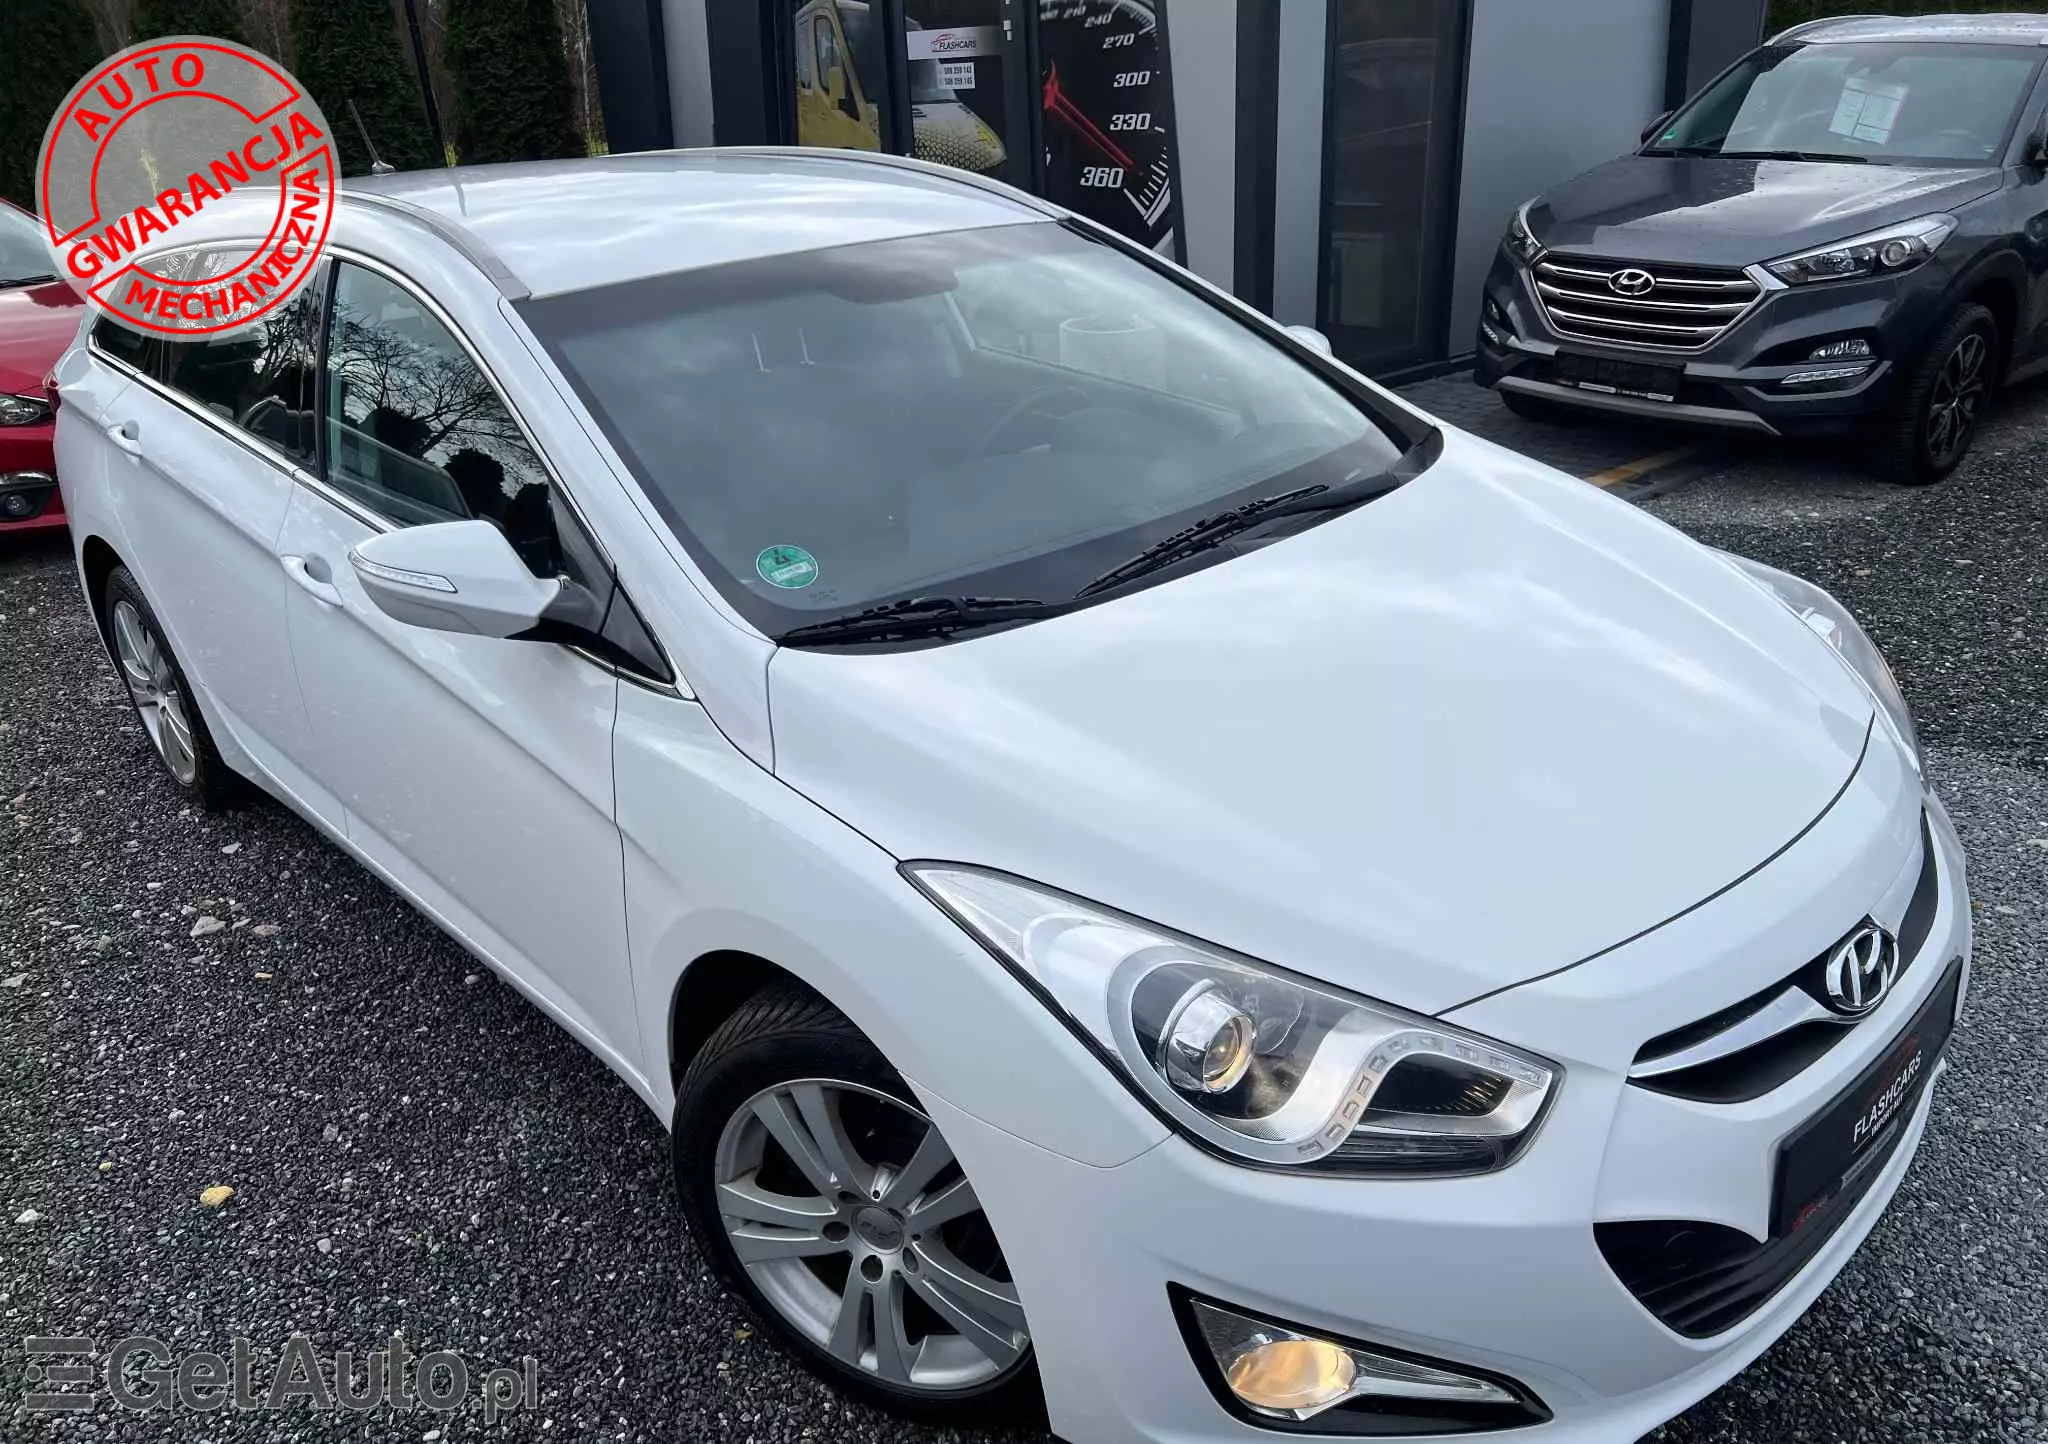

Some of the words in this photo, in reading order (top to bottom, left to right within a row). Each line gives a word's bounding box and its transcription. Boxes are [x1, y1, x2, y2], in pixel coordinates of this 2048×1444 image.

[939, 40, 977, 50] FLASHCARS
[1102, 32, 1135, 49] 270
[1113, 70, 1150, 87] 300
[1109, 113, 1151, 131] 330
[1080, 166, 1124, 188] 360
[1853, 1049, 1922, 1144] FLASHCARS
